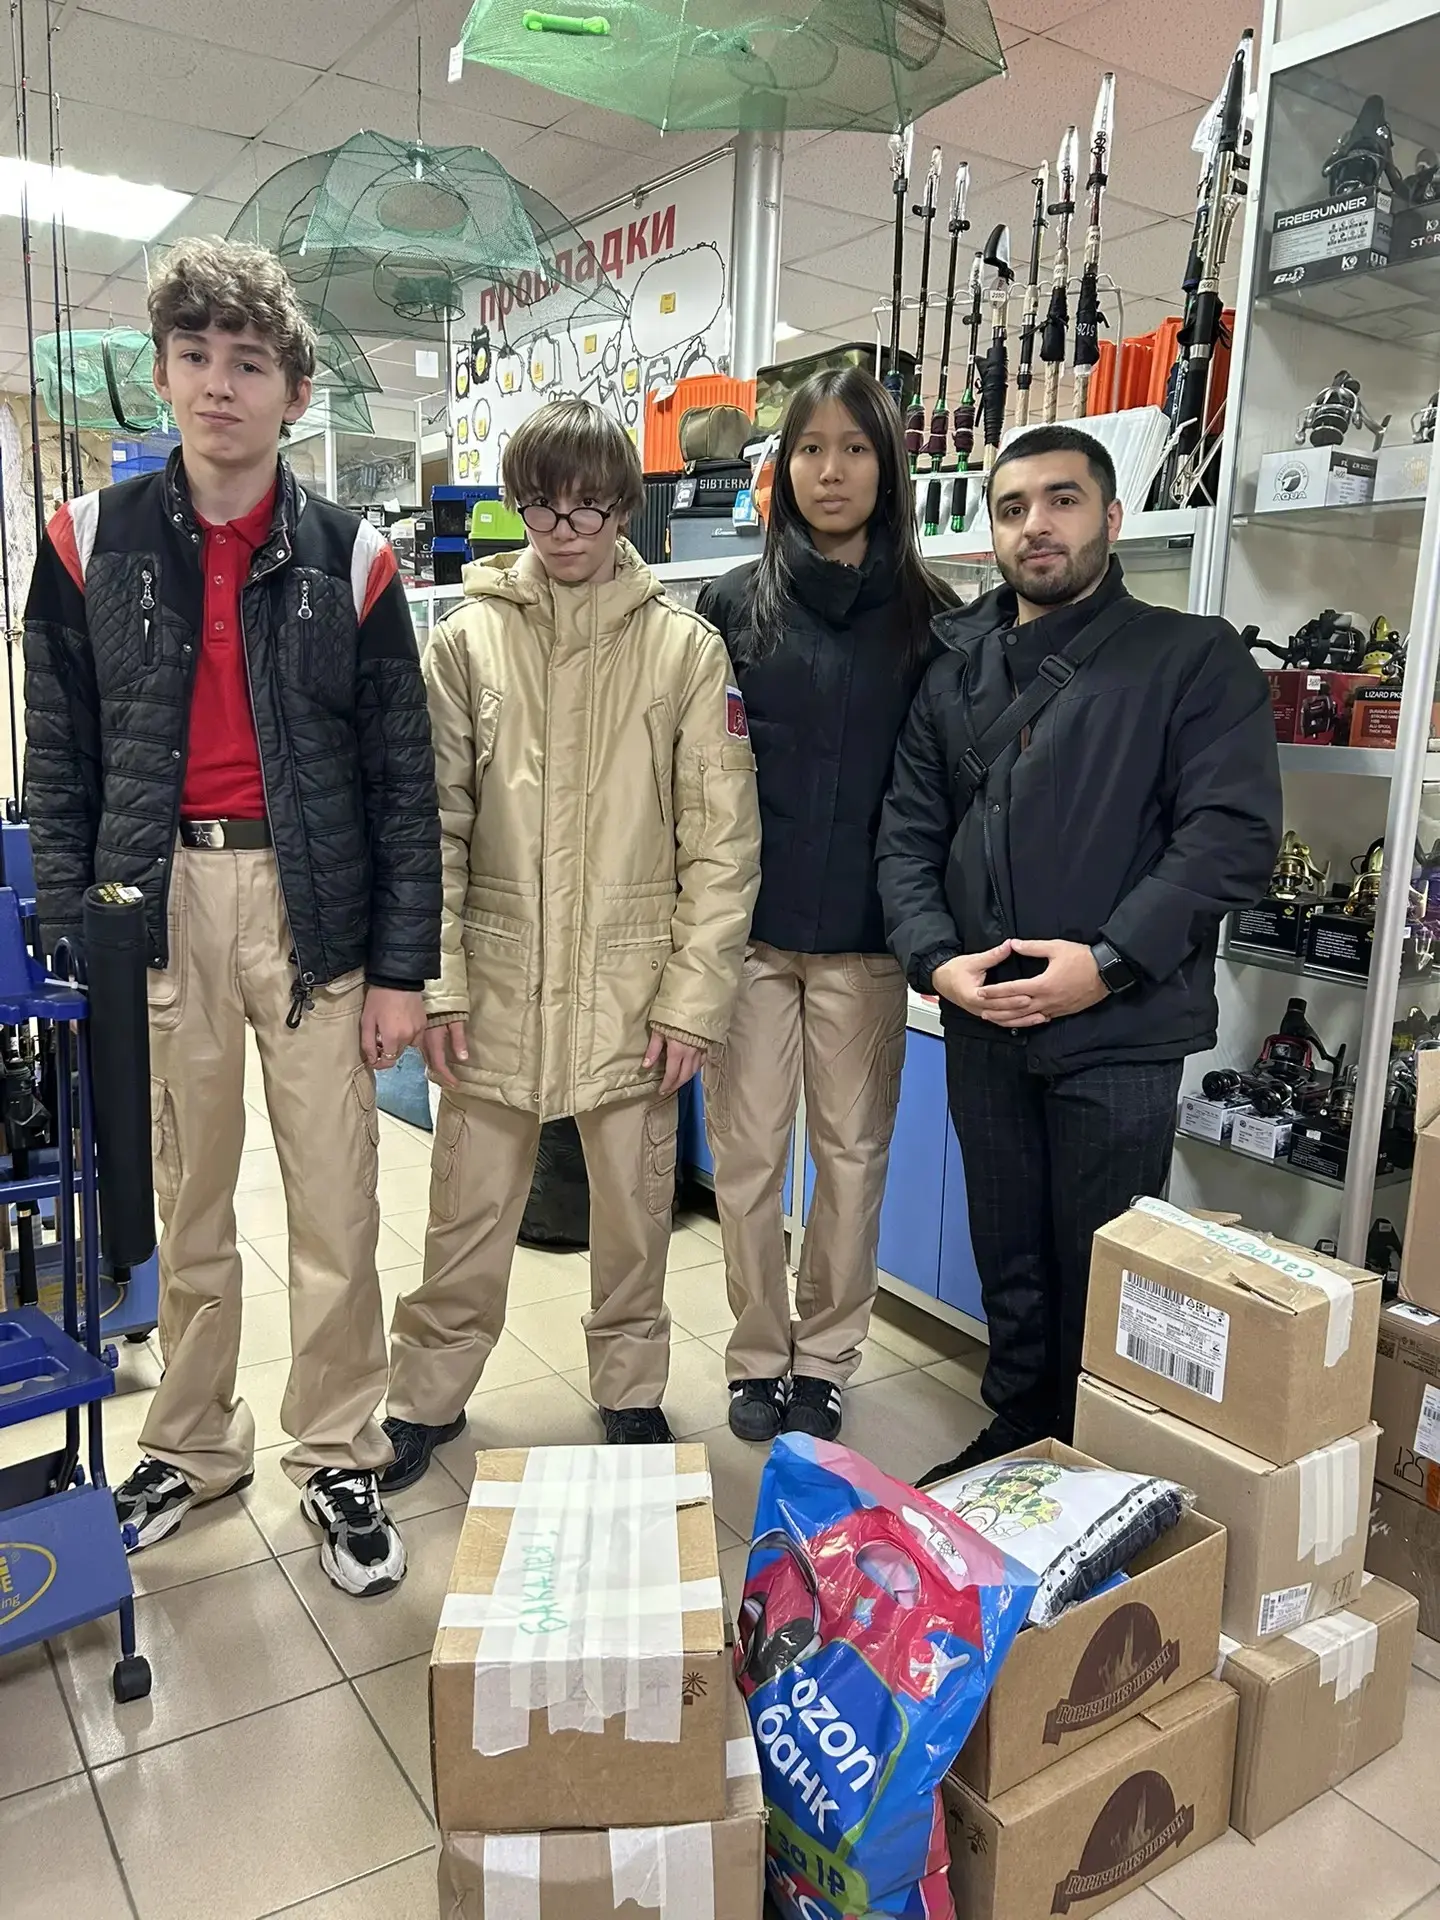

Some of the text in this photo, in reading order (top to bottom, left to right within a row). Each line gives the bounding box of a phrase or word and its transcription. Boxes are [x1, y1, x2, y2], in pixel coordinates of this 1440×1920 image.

[1277, 196, 1368, 229] FREERUNNER
[480, 204, 676, 332] прокладки
[1272, 491, 1307, 502] AQUA
[1365, 690, 1389, 699] LIZARD
[791, 1677, 877, 1792] ozon
[756, 1703, 840, 1834] банк
[778, 1836, 808, 1872] за
